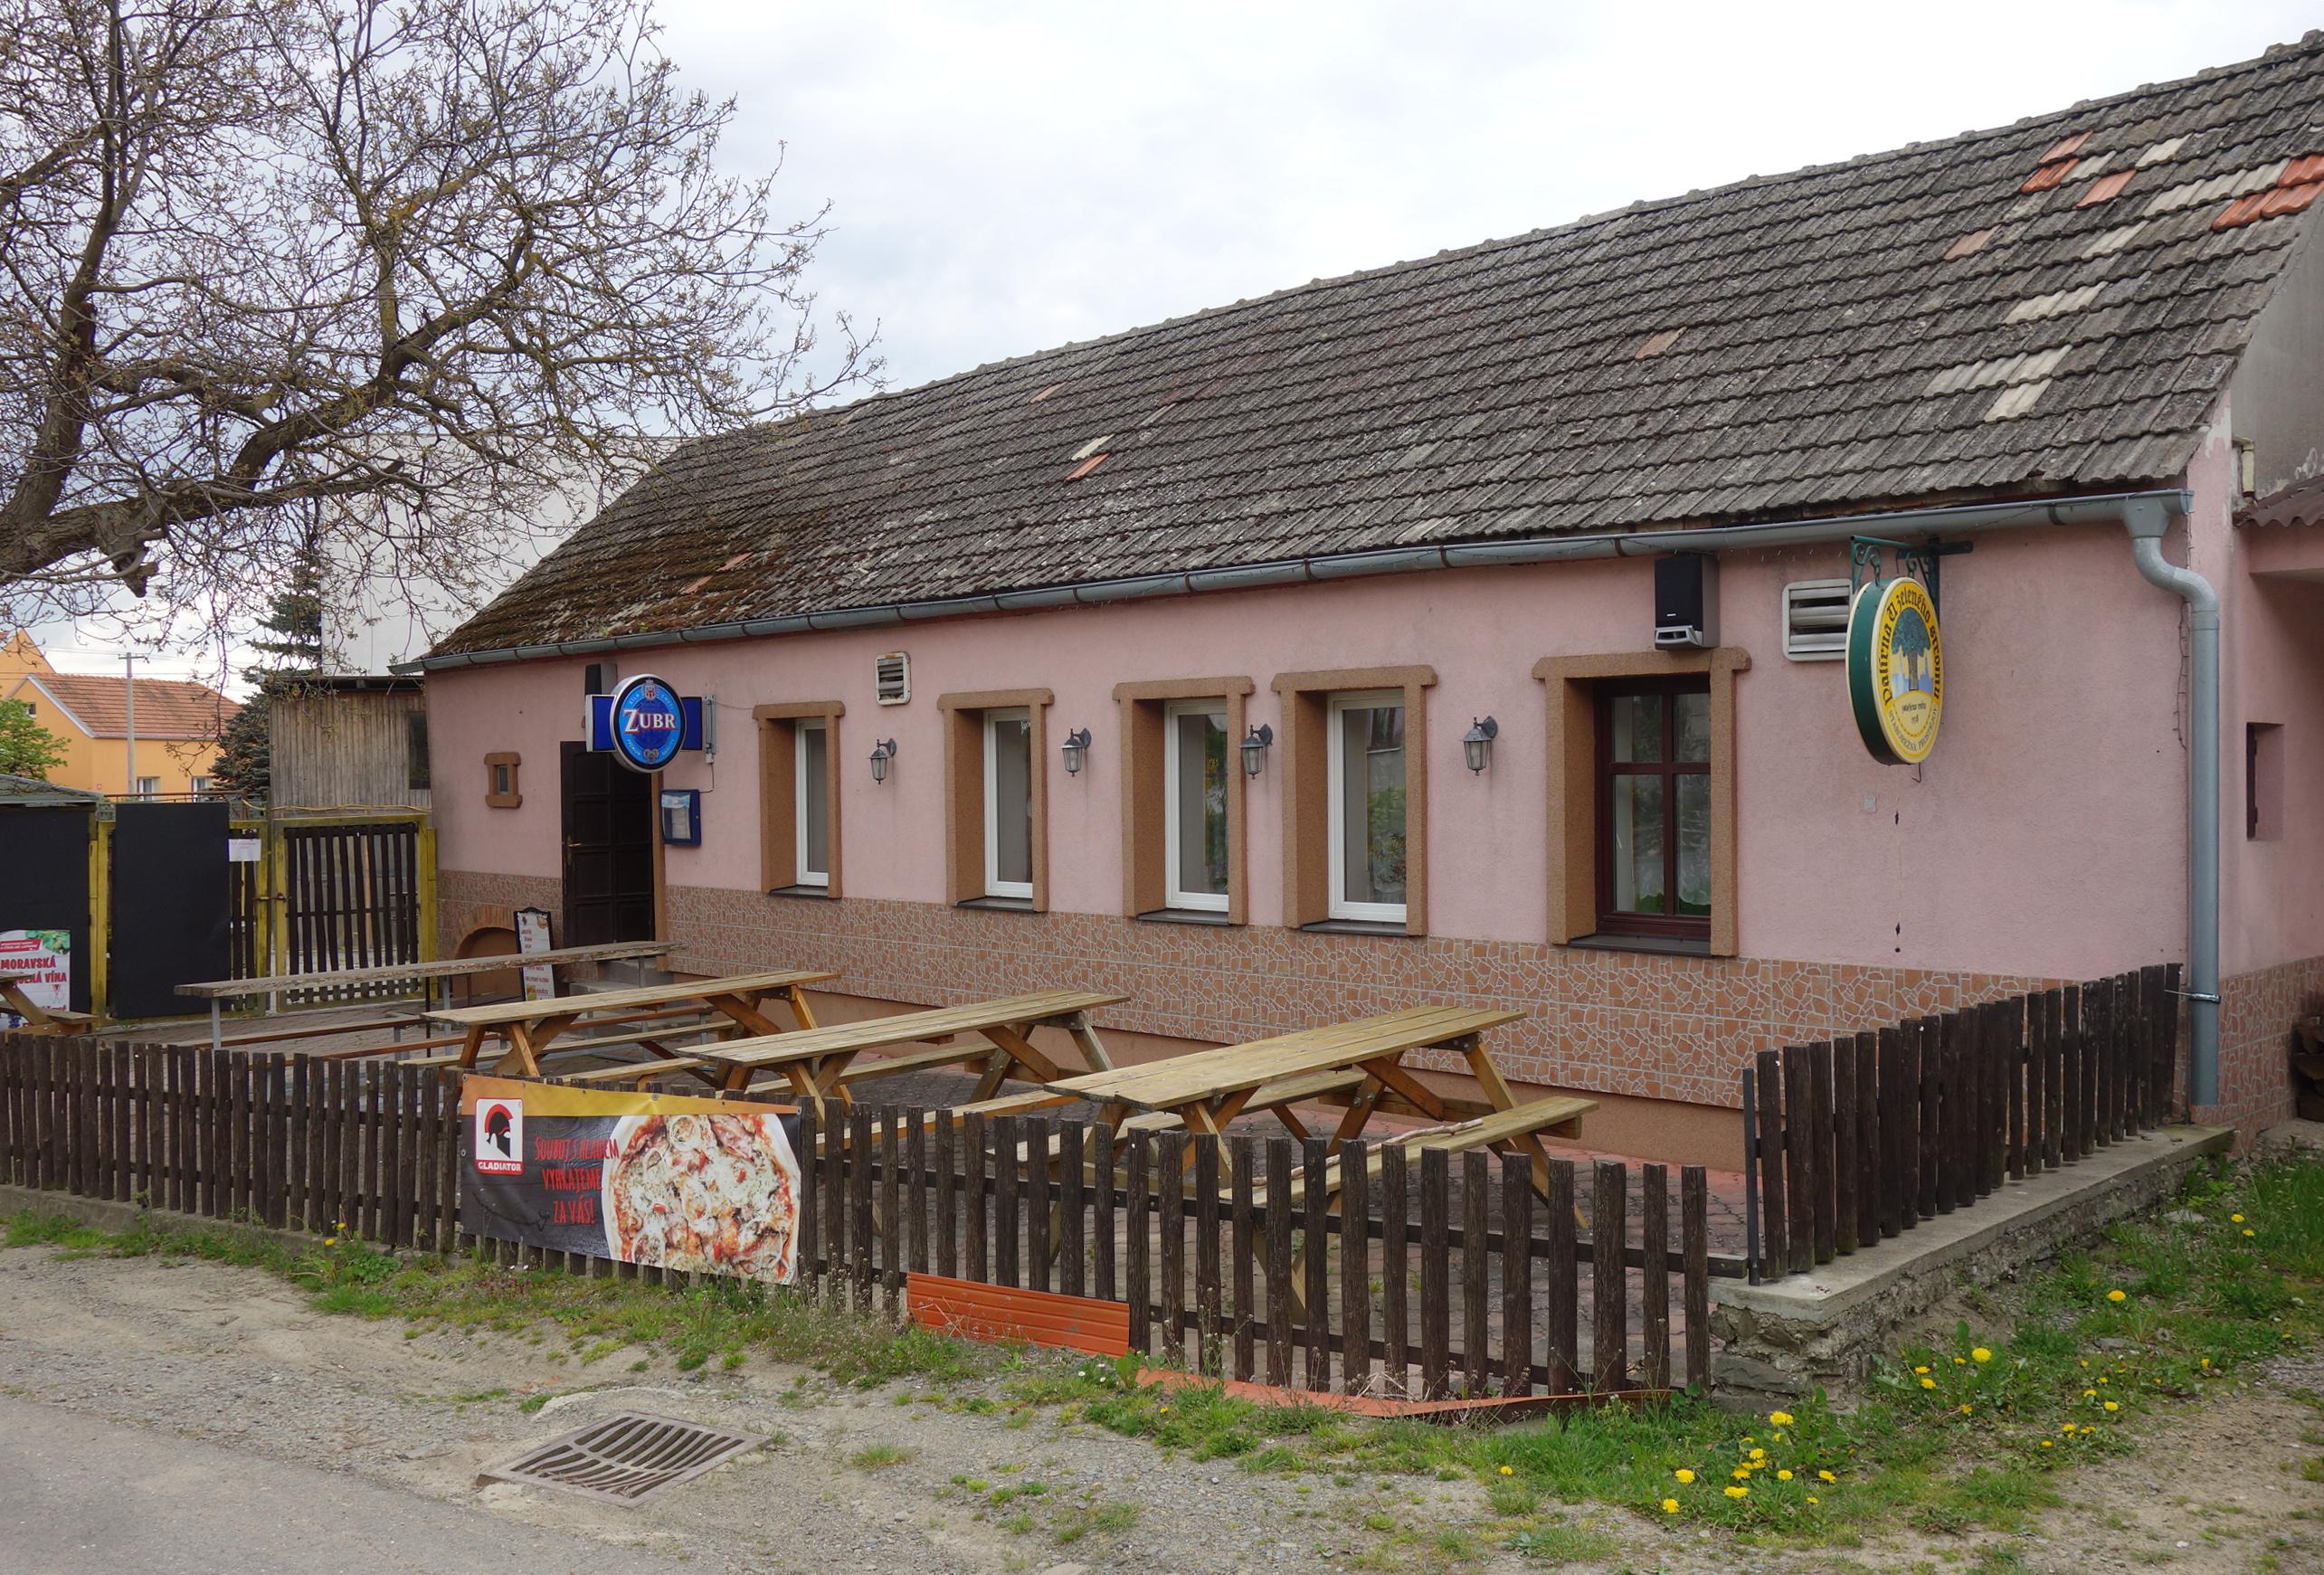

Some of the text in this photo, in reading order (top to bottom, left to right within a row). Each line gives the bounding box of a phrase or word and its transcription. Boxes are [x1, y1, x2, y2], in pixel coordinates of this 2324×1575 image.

[623, 708, 678, 734] ZUBR
[1, 955, 56, 970] MORAVSKÁ
[44, 971, 67, 983] VÍNA
[478, 1162, 522, 1172] GLADIATOR
[553, 1195, 596, 1225] ZA VÁS!
